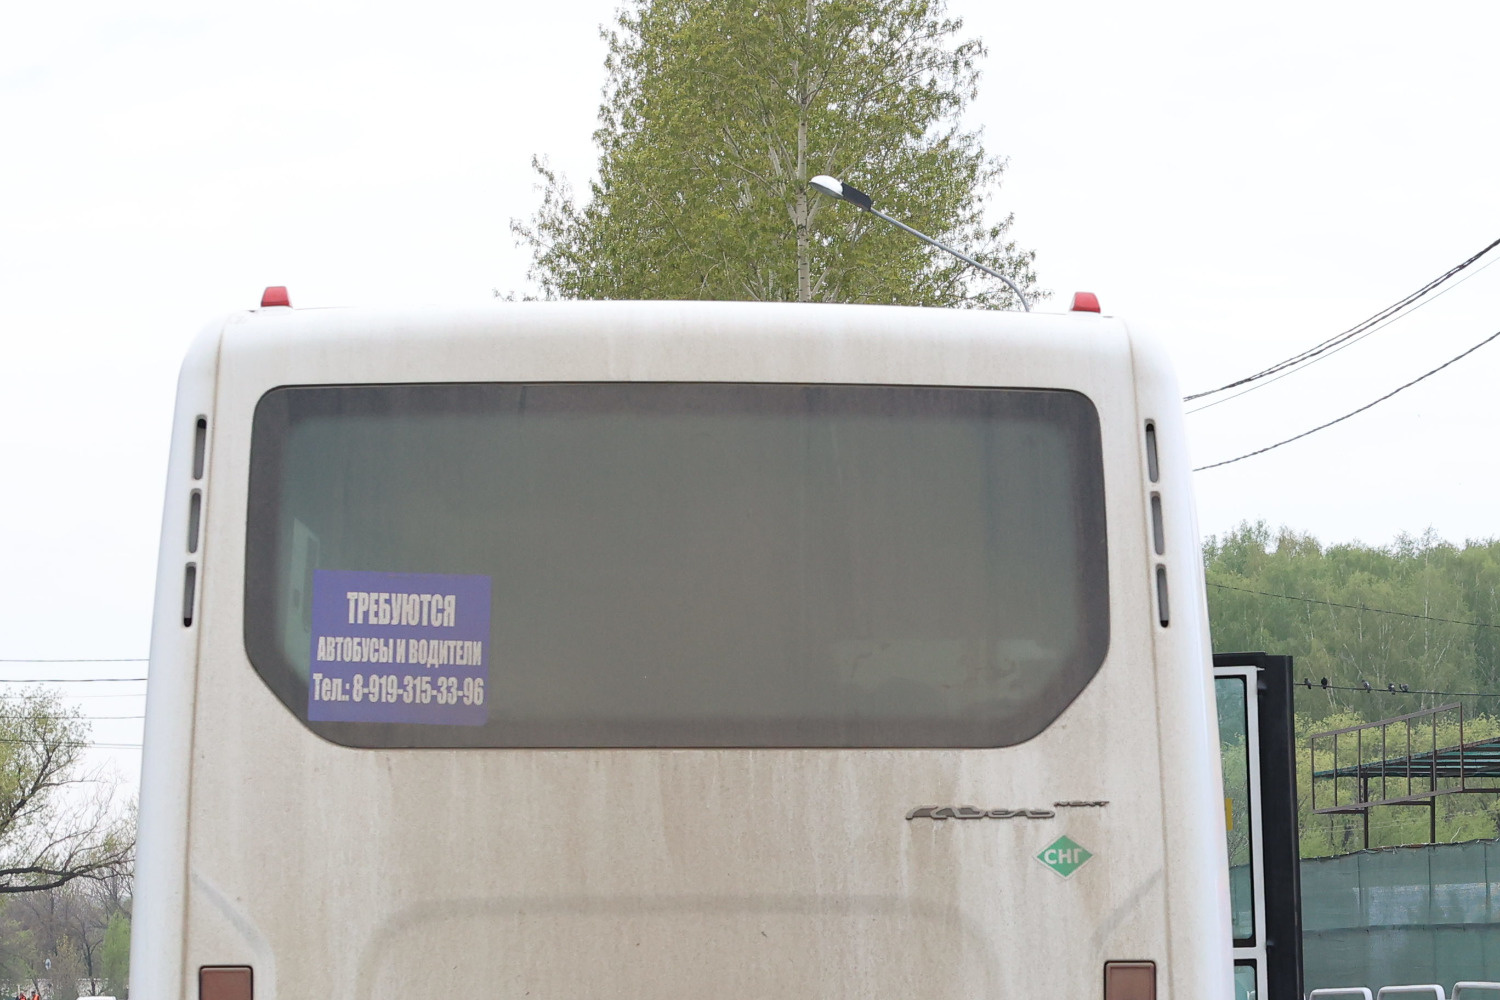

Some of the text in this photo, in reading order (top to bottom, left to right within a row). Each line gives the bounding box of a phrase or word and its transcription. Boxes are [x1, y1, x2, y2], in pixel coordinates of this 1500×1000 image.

[346, 591, 456, 627] ТРЕБУЮТСЯ
[317, 636, 482, 668] АВТОБУСЫ И ВОДИТЕЛИ
[313, 672, 485, 706] Тел.: 8-919-315-33-96
